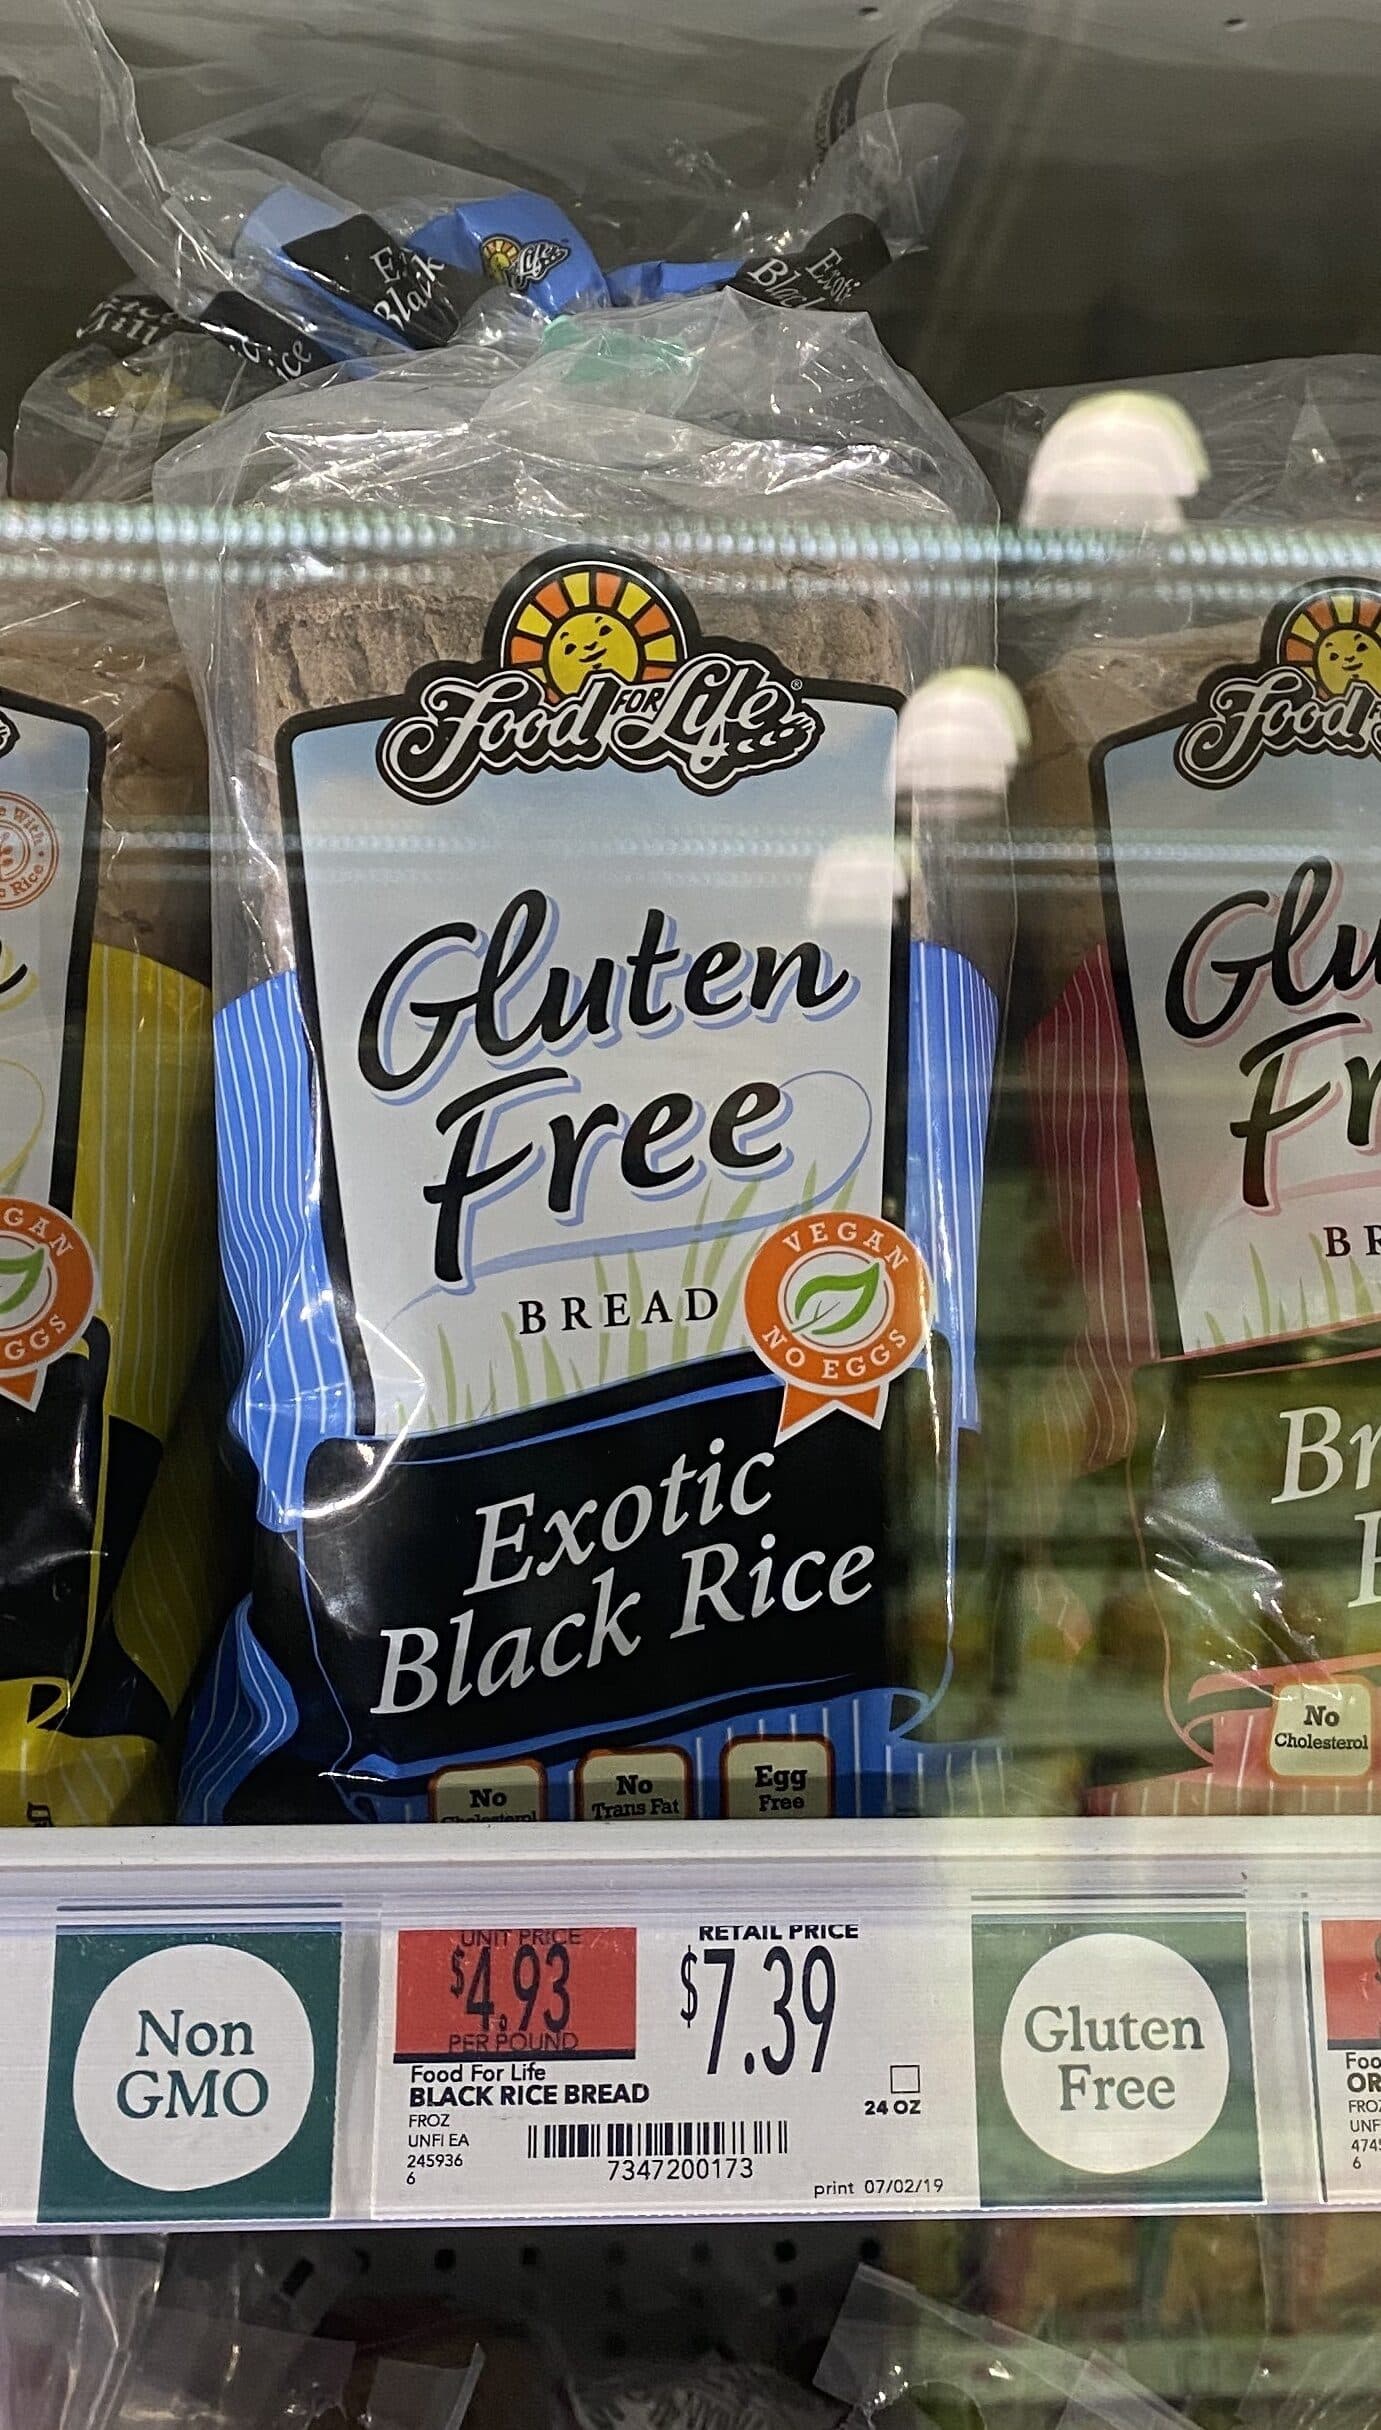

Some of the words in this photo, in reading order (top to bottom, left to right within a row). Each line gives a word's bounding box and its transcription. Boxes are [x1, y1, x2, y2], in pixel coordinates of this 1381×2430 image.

[610, 687, 665, 715] FOR
[614, 657, 800, 775] Life
[1184, 671, 1366, 772] Food
[389, 678, 606, 782] Food
[357, 889, 852, 1092] Gluten
[423, 1066, 783, 1284] Free
[783, 1221, 909, 1271] VEGAN
[517, 1286, 720, 1336] BREAD
[762, 1324, 806, 1368] NO
[821, 1328, 907, 1379] EGGS
[463, 1437, 776, 1597] Exotic
[370, 1566, 642, 1715] Black
[670, 1533, 875, 1640] Rice
[1304, 1705, 1340, 1728] No
[1274, 1732, 1369, 1750] Cholesterol
[616, 1774, 653, 1795] No
[754, 1764, 808, 1792] Egg
[469, 1788, 507, 1808] No
[591, 1802, 646, 1820] Trans
[650, 1798, 680, 1815] Fat
[759, 1794, 805, 1811] Free
[461, 1929, 513, 1947] UNIT
[519, 1928, 582, 1944] PRICE
[699, 1925, 783, 1941] RETAIL
[789, 1924, 859, 1939] PRICE
[451, 1944, 571, 2033] $4.93
[680, 1945, 836, 2075] $7.39
[136, 2009, 255, 2057] Non
[1024, 2005, 1206, 2052] Gluten
[448, 2034, 490, 2051] PER
[496, 2032, 579, 2050] POUND
[411, 2065, 463, 2083] Food
[471, 2064, 504, 2082] For
[511, 2062, 547, 2081] Life
[117, 2068, 269, 2119] GMO
[409, 2085, 495, 2107] BLACK
[501, 2084, 558, 2106] RICE
[564, 2083, 650, 2104] BREAD
[1058, 2064, 1176, 2111] Free
[864, 2100, 888, 2115] 24
[893, 2099, 921, 2115] OZ
[409, 2114, 450, 2127] FROZ
[408, 2134, 444, 2147] UNFI
[449, 2133, 470, 2147] EA
[406, 2154, 463, 2168] 245936
[608, 2157, 754, 2181] 7347200173
[1353, 2155, 1362, 2169] 6
[406, 2172, 416, 2185] 6
[814, 2179, 855, 2198] print
[864, 2178, 944, 2194] 07/02/19
